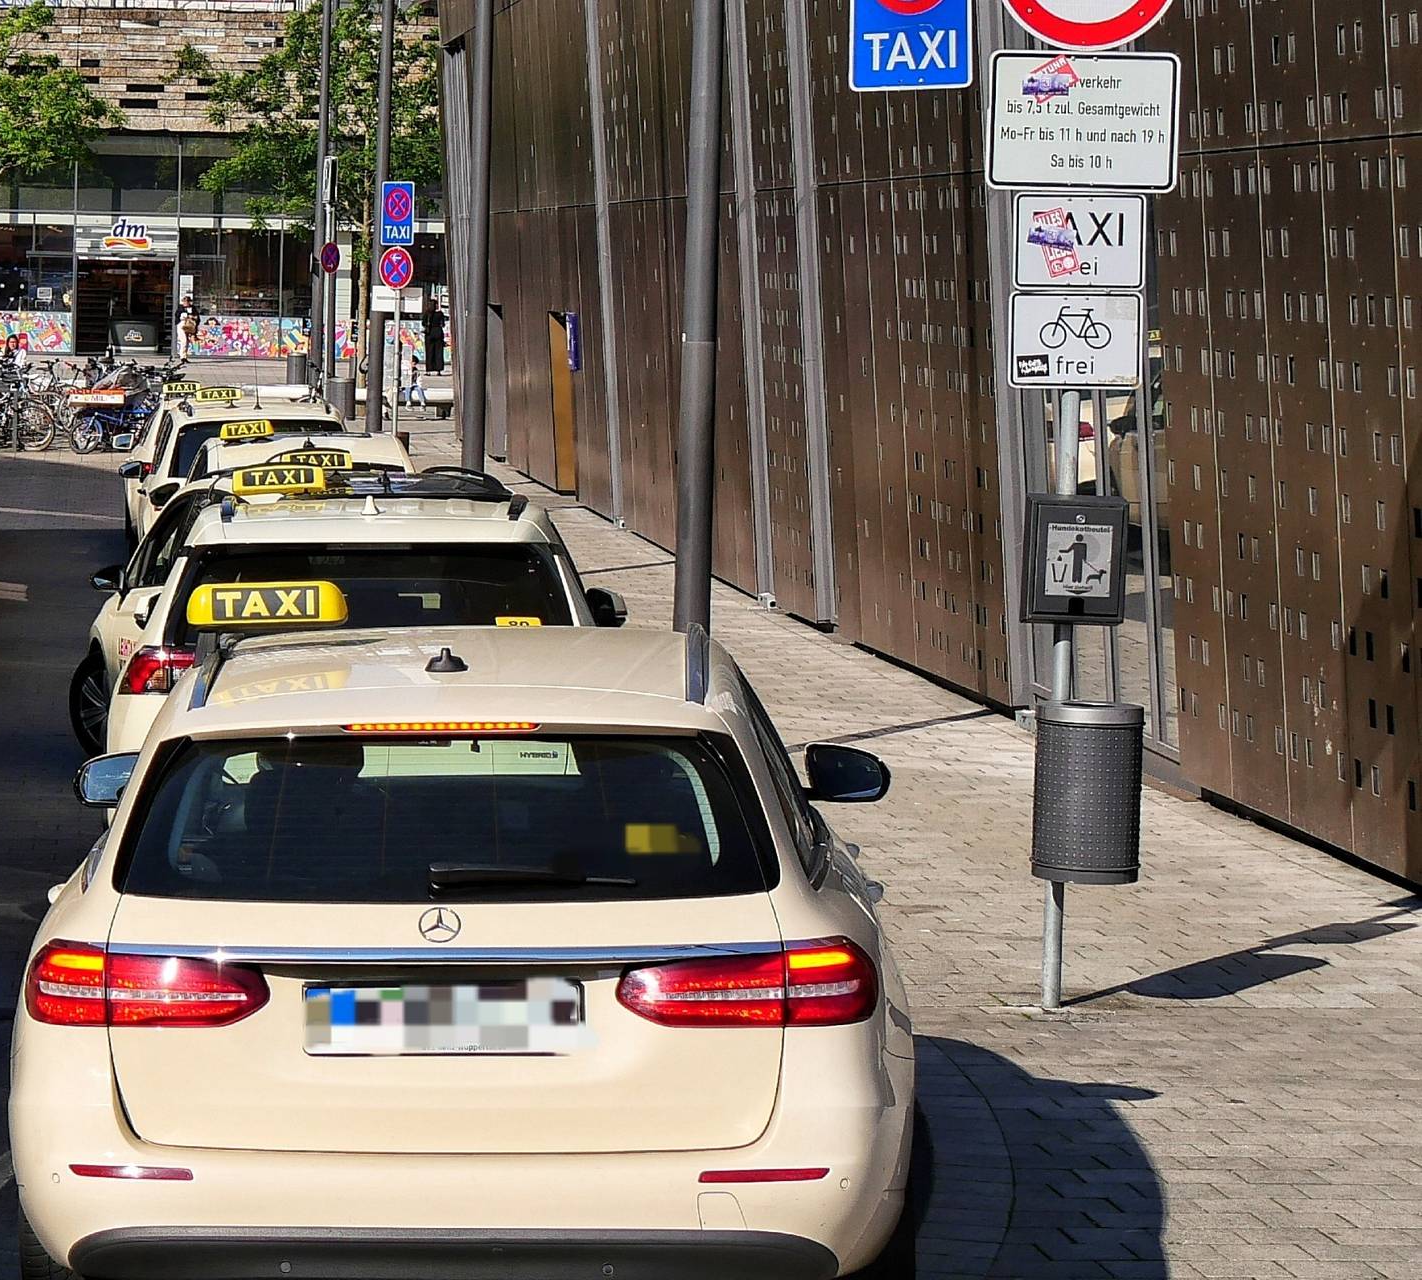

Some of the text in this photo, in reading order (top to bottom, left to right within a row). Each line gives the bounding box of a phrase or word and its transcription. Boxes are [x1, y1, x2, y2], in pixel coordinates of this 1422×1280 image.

[863, 30, 957, 71] TAXI
[1007, 100, 1161, 120] bis 7,5 t zul. Gesamtgewicht
[1001, 127, 1165, 144] Mo-Fr bis 11 h und nach 19 h
[1050, 154, 1113, 169] Sa bis 10 h
[113, 219, 145, 238] dm
[385, 225, 410, 239] TAXI
[1032, 210, 1125, 247] AXI
[1056, 356, 1094, 374] frei
[170, 383, 196, 392] TAXI
[206, 390, 233, 398] TAXI
[228, 421, 266, 435] TAXI
[296, 454, 339, 467] TAXI
[251, 470, 306, 486] TAXI
[216, 589, 316, 618] TAXI
